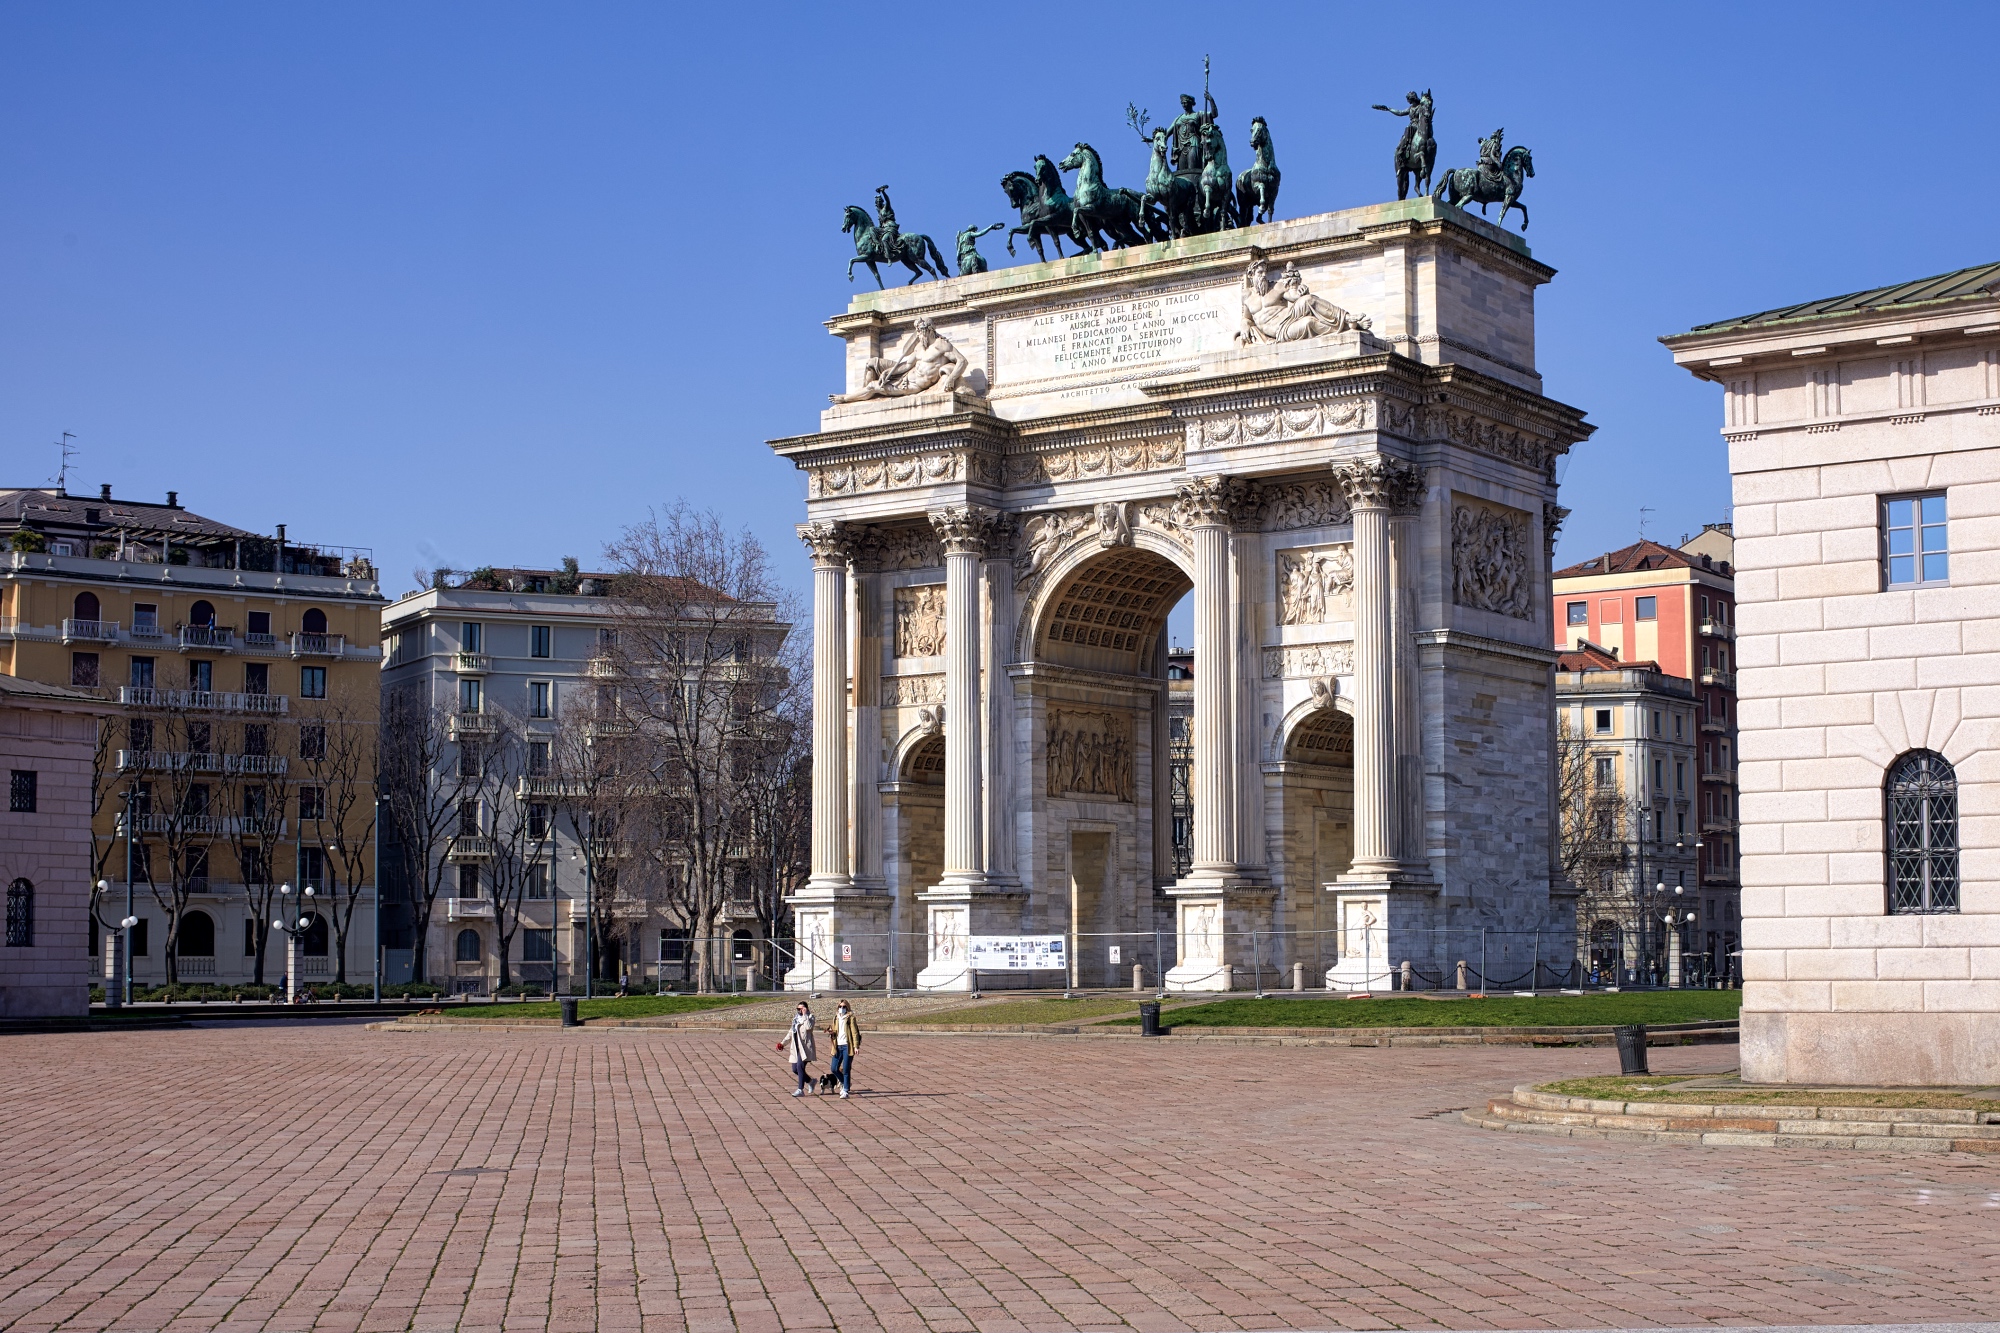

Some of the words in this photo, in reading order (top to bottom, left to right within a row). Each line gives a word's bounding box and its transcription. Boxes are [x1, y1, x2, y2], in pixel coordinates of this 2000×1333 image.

[1033, 316, 1055, 327] ALLE
[1060, 308, 1104, 322] SPERANZE
[1110, 305, 1126, 315] DEL
[1132, 299, 1160, 311] REGNO
[1165, 293, 1200, 306] ITALICO
[1069, 319, 1100, 331] AUSPICE
[1106, 310, 1153, 325] NAPOLEONE
[1026, 334, 1066, 347] MILANESI
[1072, 325, 1128, 340] DEDICARONO
[1172, 310, 1219, 325] MDCCCVII
[1055, 347, 1111, 363] FELICEMENTE
[1117, 336, 1183, 353] RESTITUIRONO
[1072, 336, 1114, 350] FRANCATI
[1121, 334, 1133, 343] DA
[1112, 349, 1162, 364] MDCCCLIX
[1060, 386, 1110, 399] ARCHITETTO
